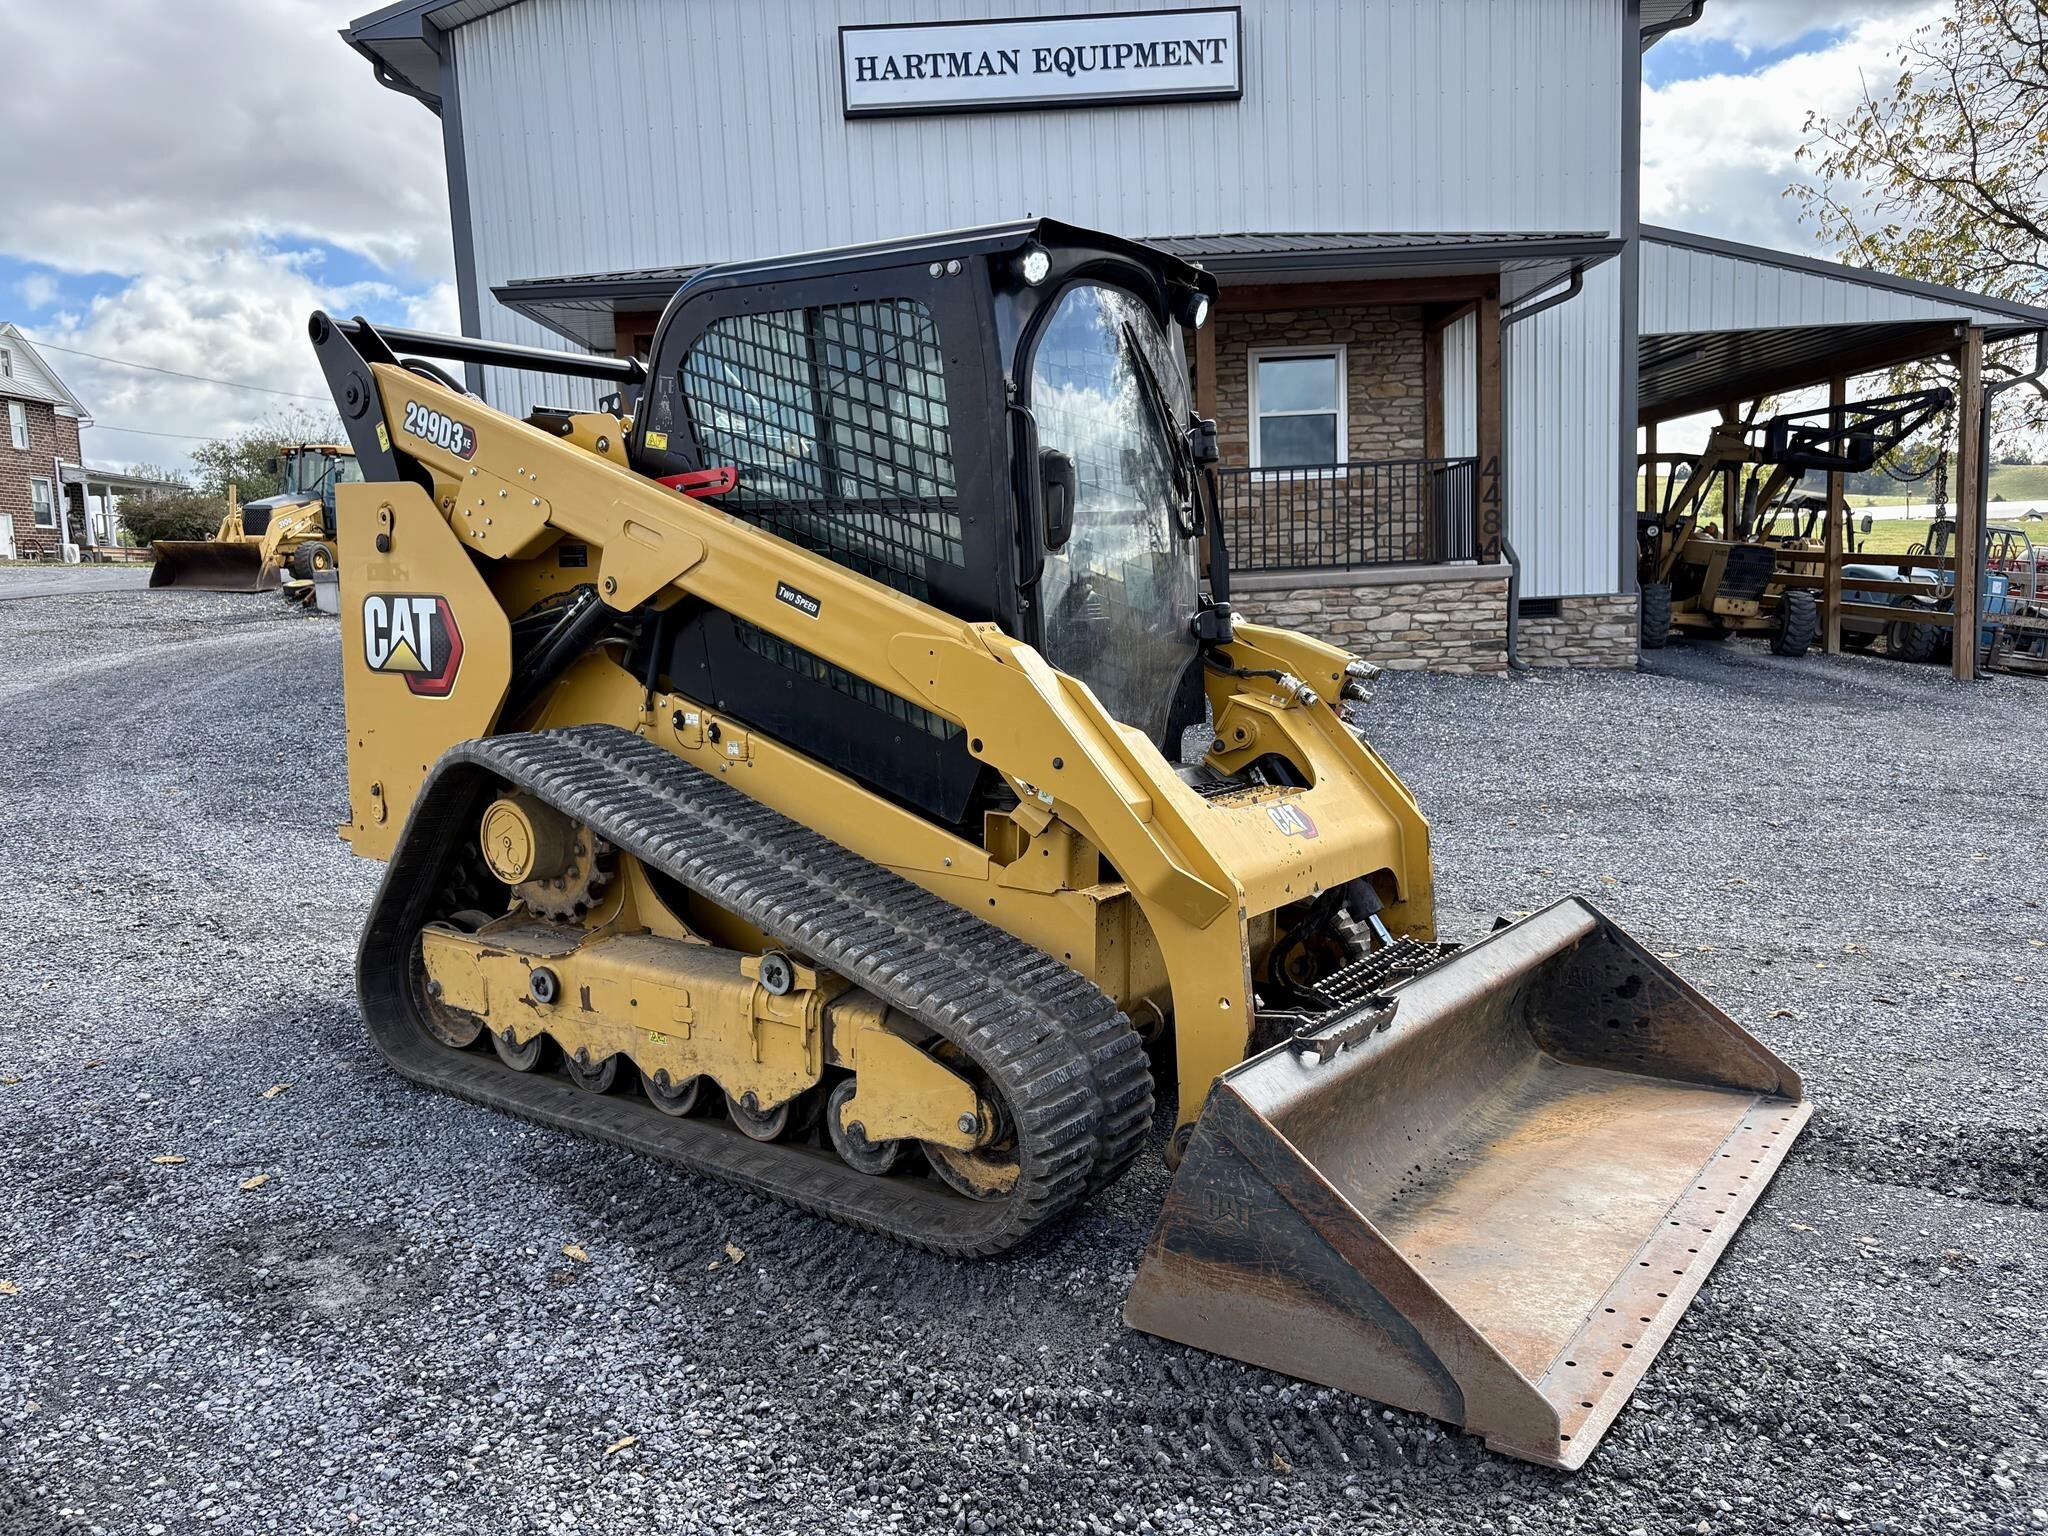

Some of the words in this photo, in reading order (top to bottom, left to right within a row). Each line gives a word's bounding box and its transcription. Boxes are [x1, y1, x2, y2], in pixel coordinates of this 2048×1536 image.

[855, 49, 1020, 82] HARTMAN
[1032, 38, 1227, 78] EQUIPMENT
[403, 400, 464, 454] 299D3
[1482, 455, 1501, 564] 4484
[364, 596, 437, 671] CAT
[1266, 804, 1309, 836] CAT
